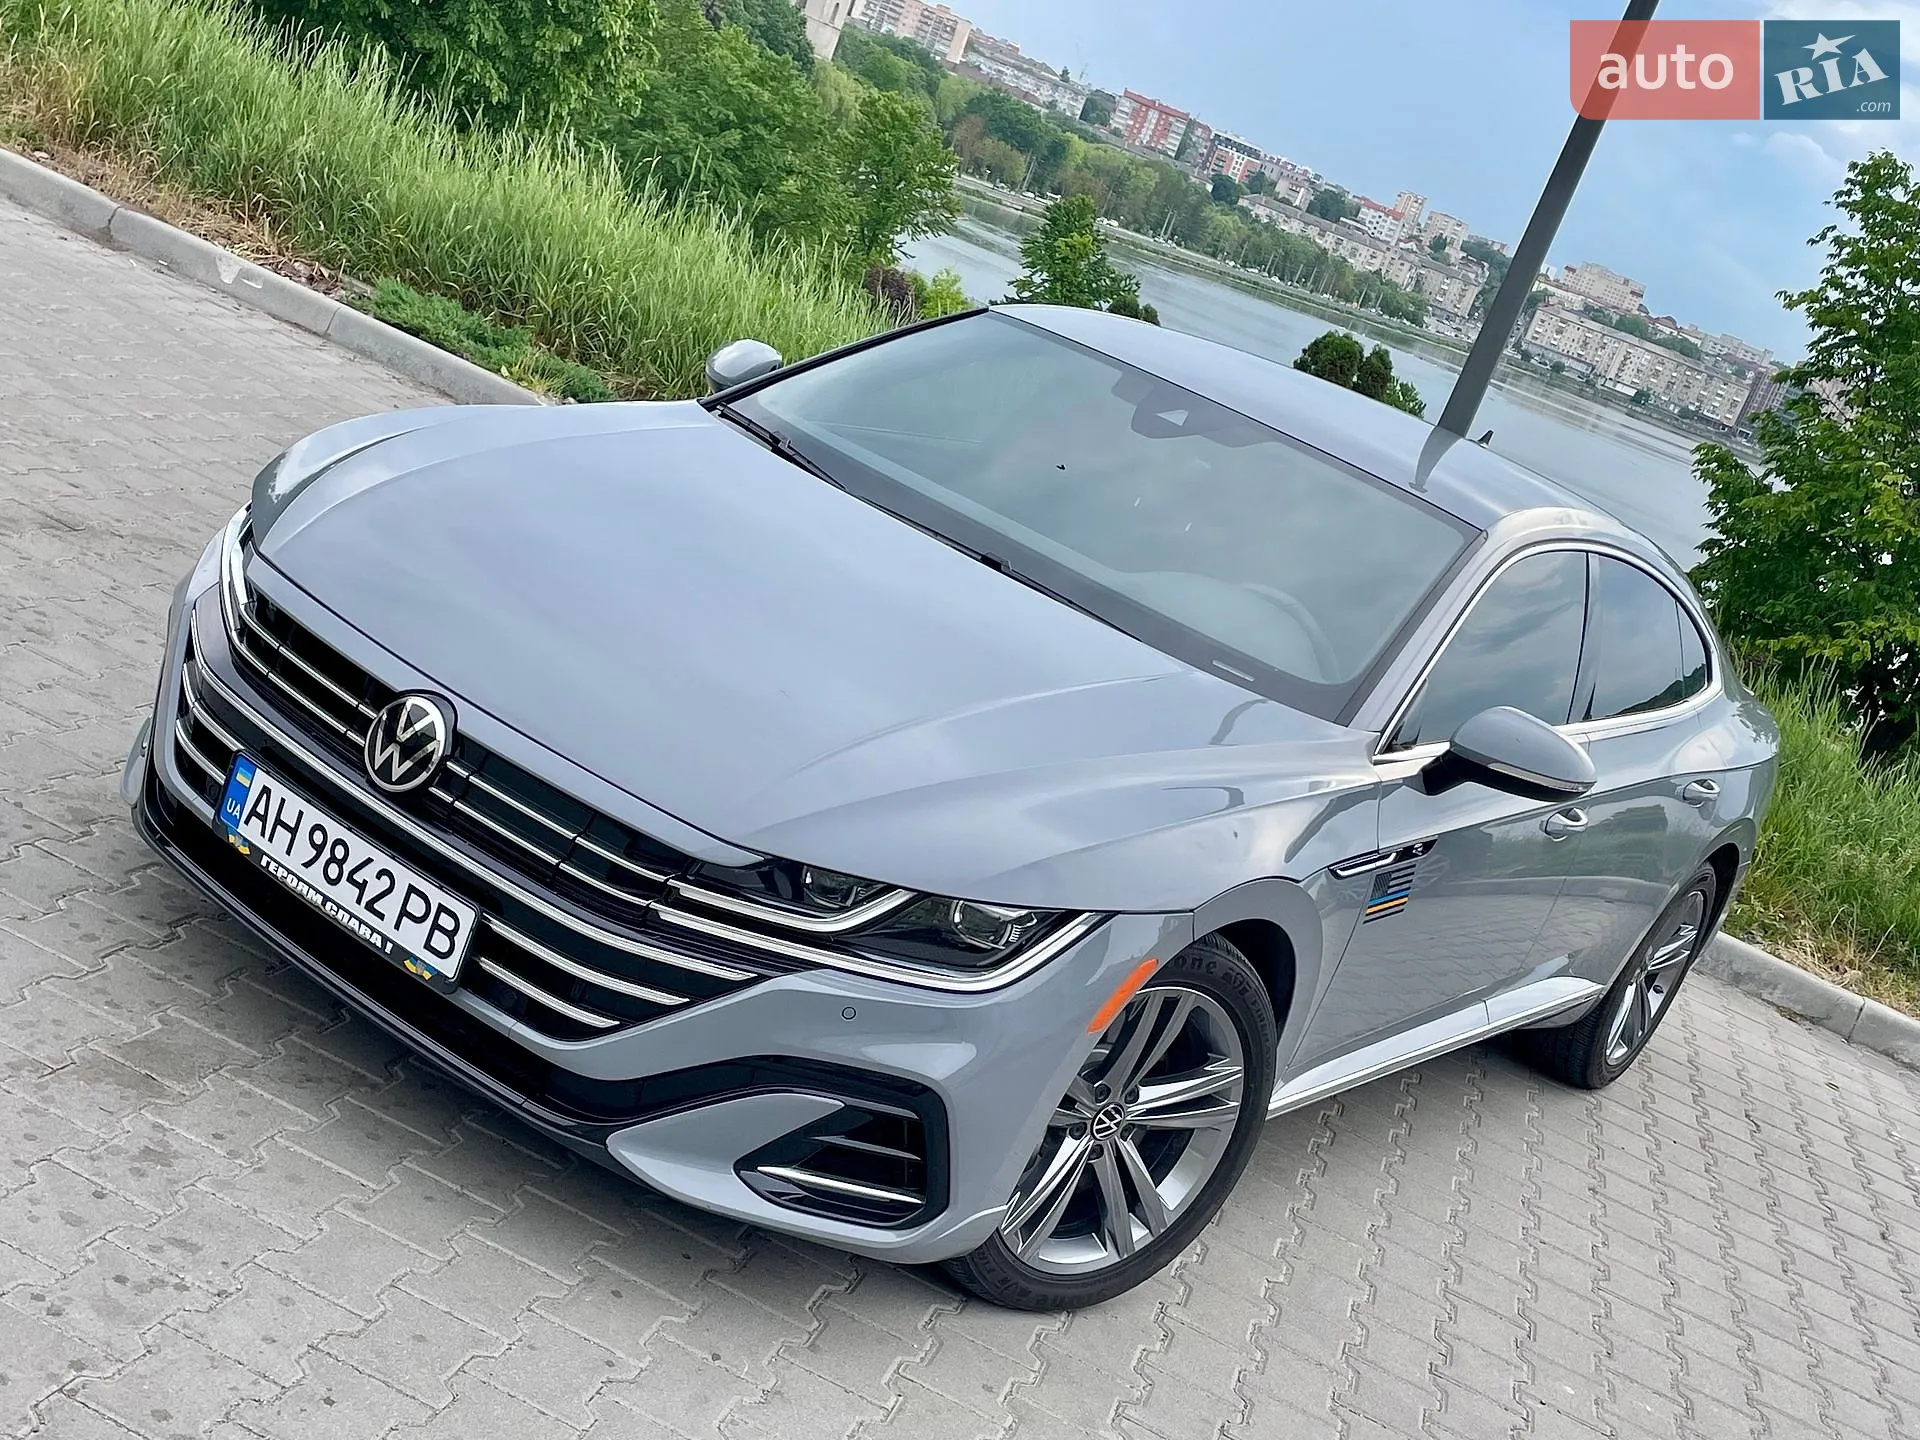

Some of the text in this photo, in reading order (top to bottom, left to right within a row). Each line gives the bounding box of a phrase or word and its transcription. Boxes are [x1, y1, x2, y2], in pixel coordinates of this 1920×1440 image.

[226, 797, 241, 820] UA
[243, 784, 461, 960] AH 9842 PB
[260, 854, 324, 906] ГЕРОЯМ
